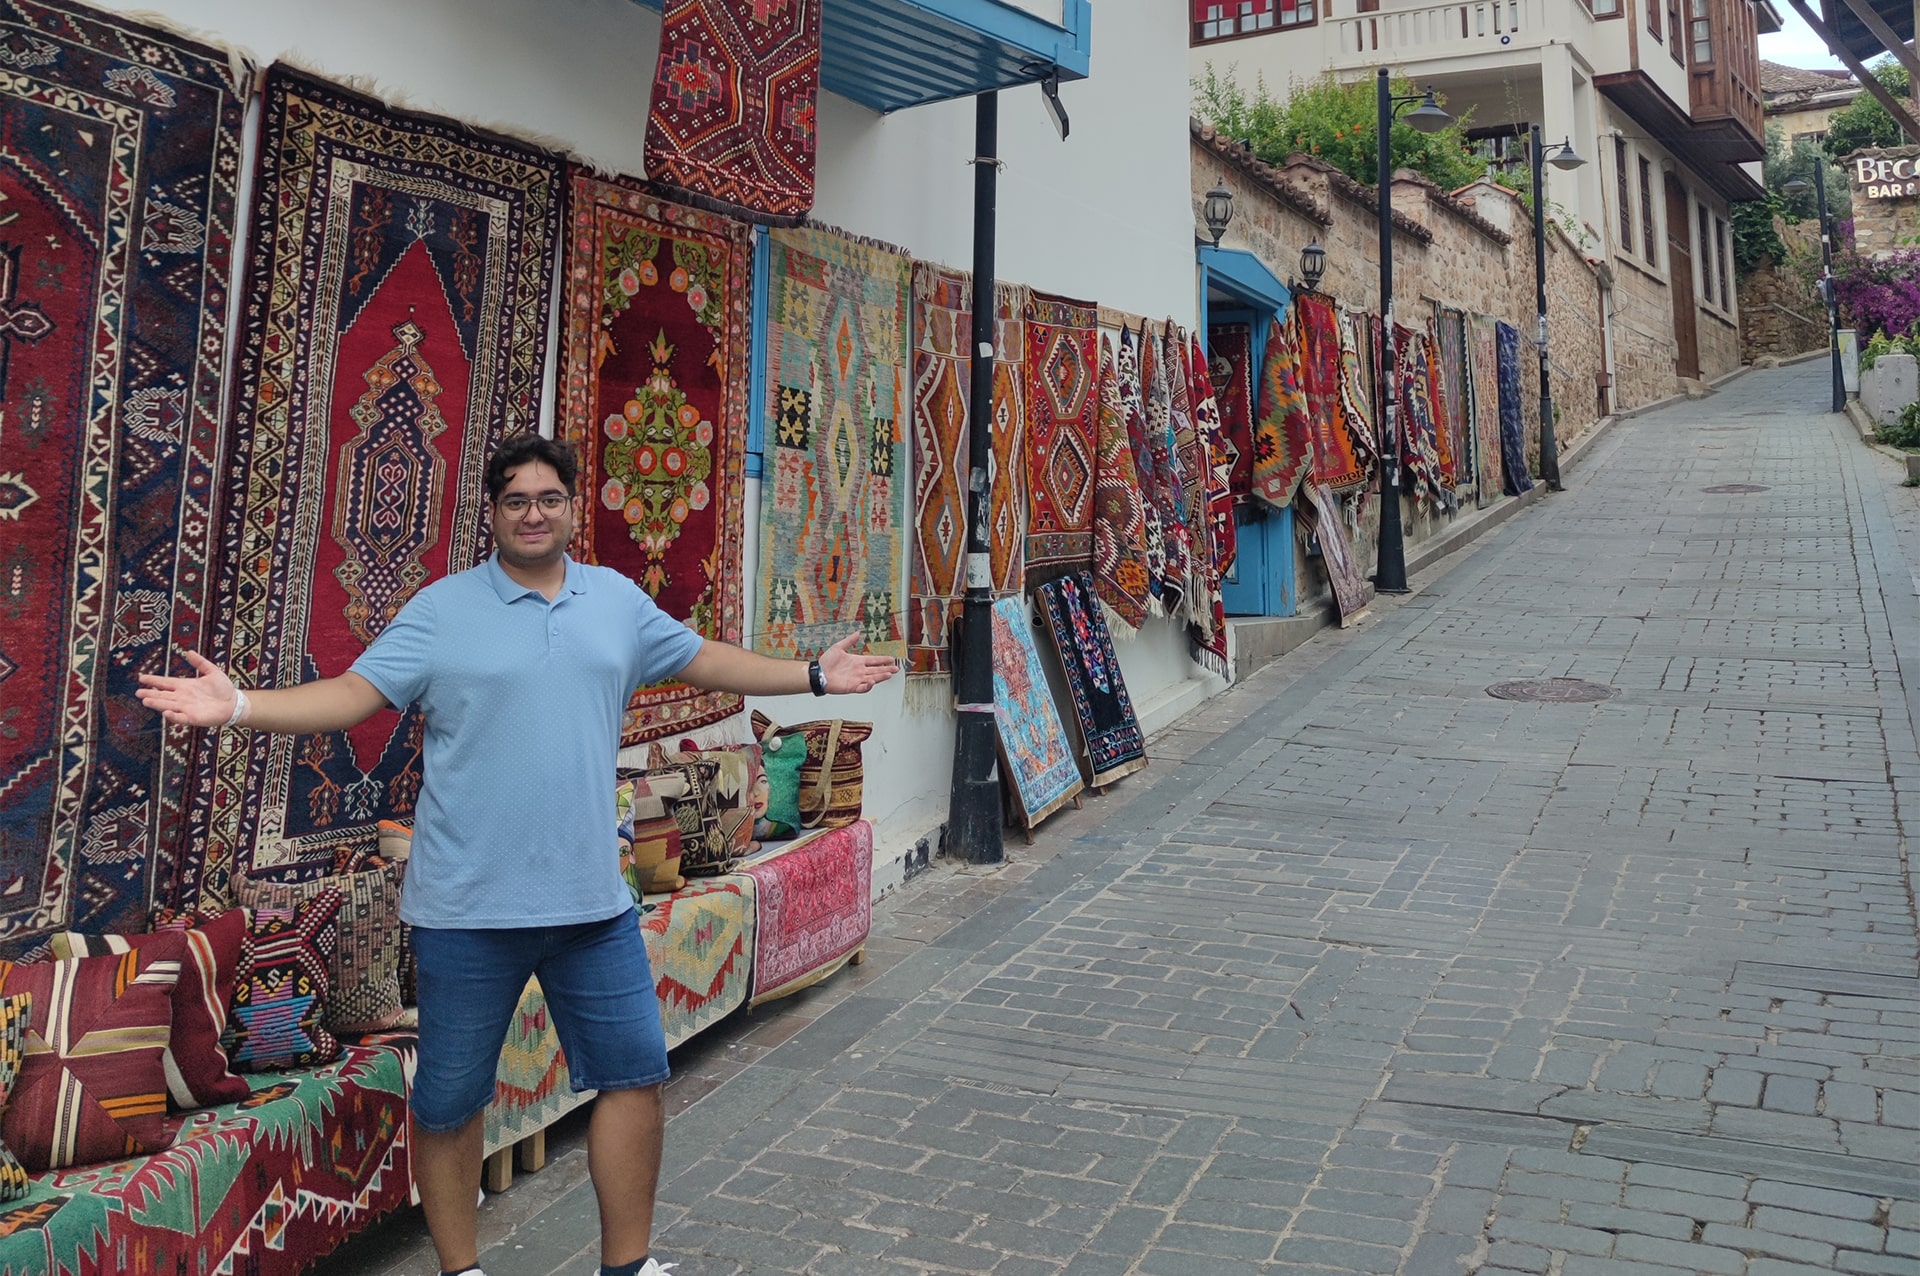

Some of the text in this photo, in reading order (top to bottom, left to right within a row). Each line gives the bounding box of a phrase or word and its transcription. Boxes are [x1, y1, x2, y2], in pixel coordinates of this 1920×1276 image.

[1856, 157, 1920, 183] BEC
[1868, 182, 1917, 199] BAR &
